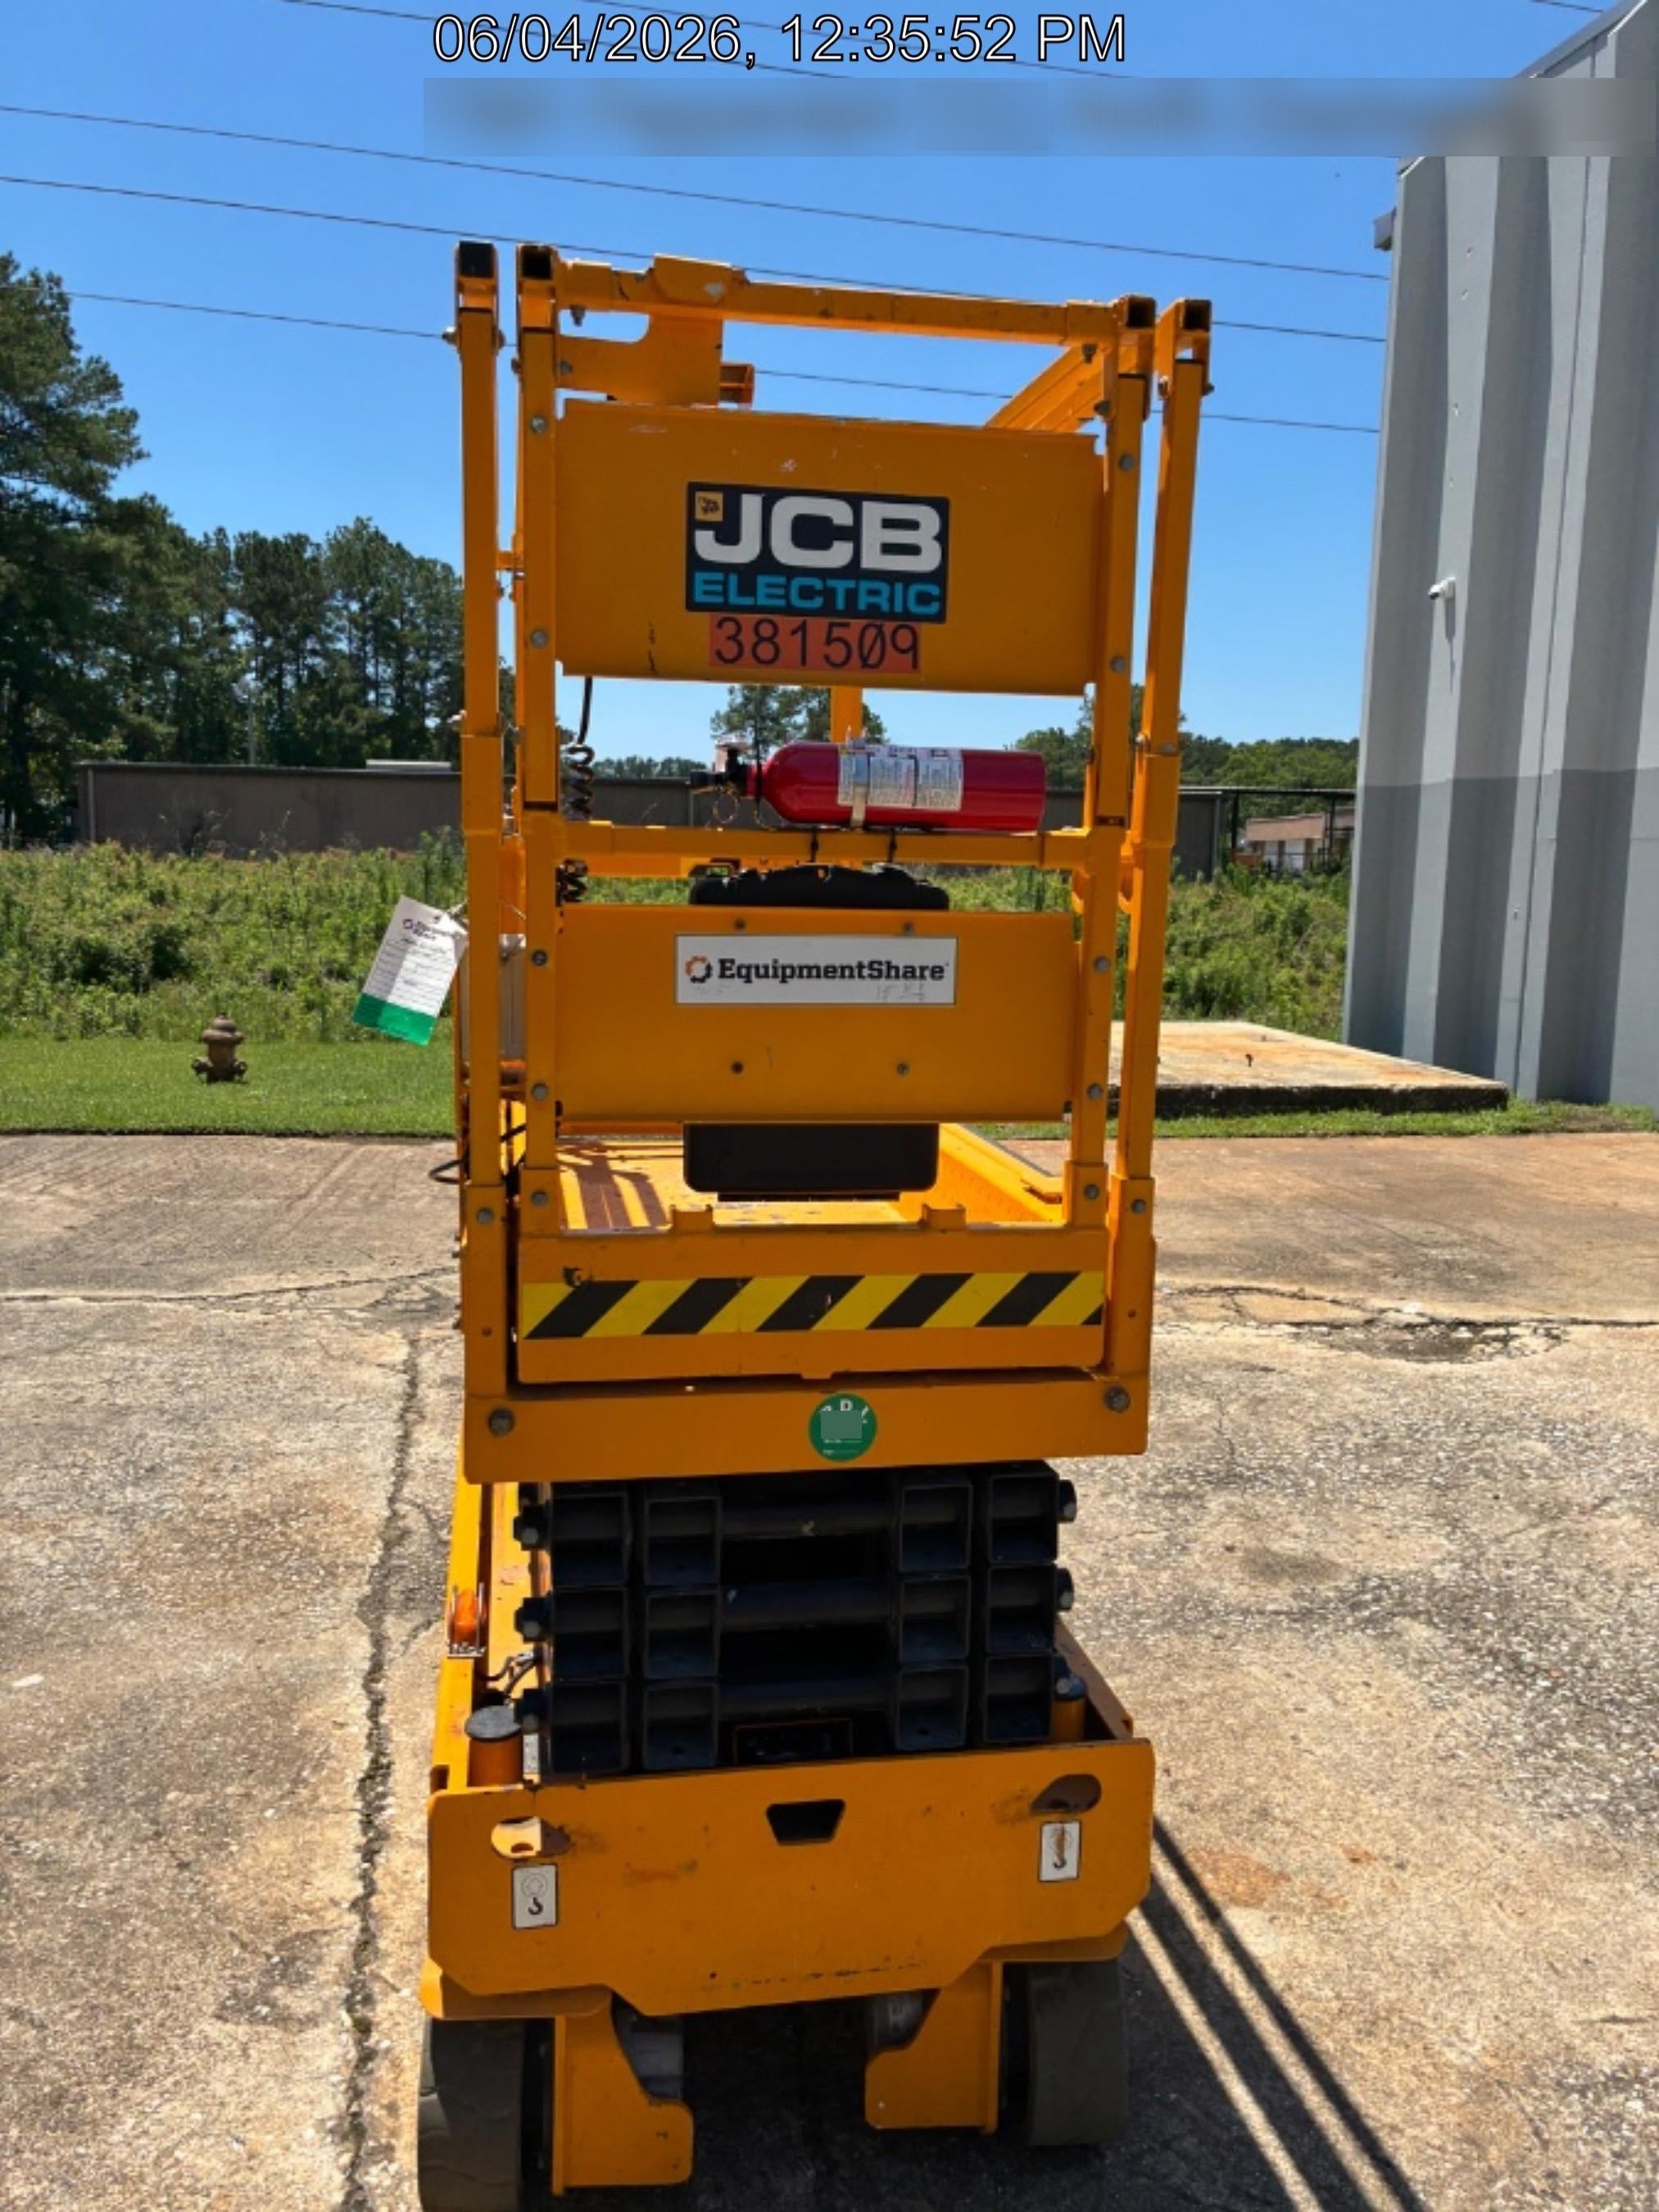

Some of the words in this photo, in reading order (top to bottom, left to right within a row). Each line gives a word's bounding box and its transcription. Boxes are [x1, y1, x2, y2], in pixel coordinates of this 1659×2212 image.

[695, 493, 942, 572] JCB
[693, 572, 941, 614] ELECTRIC
[714, 618, 919, 669] 381509
[718, 959, 945, 983] EquipmentShare
